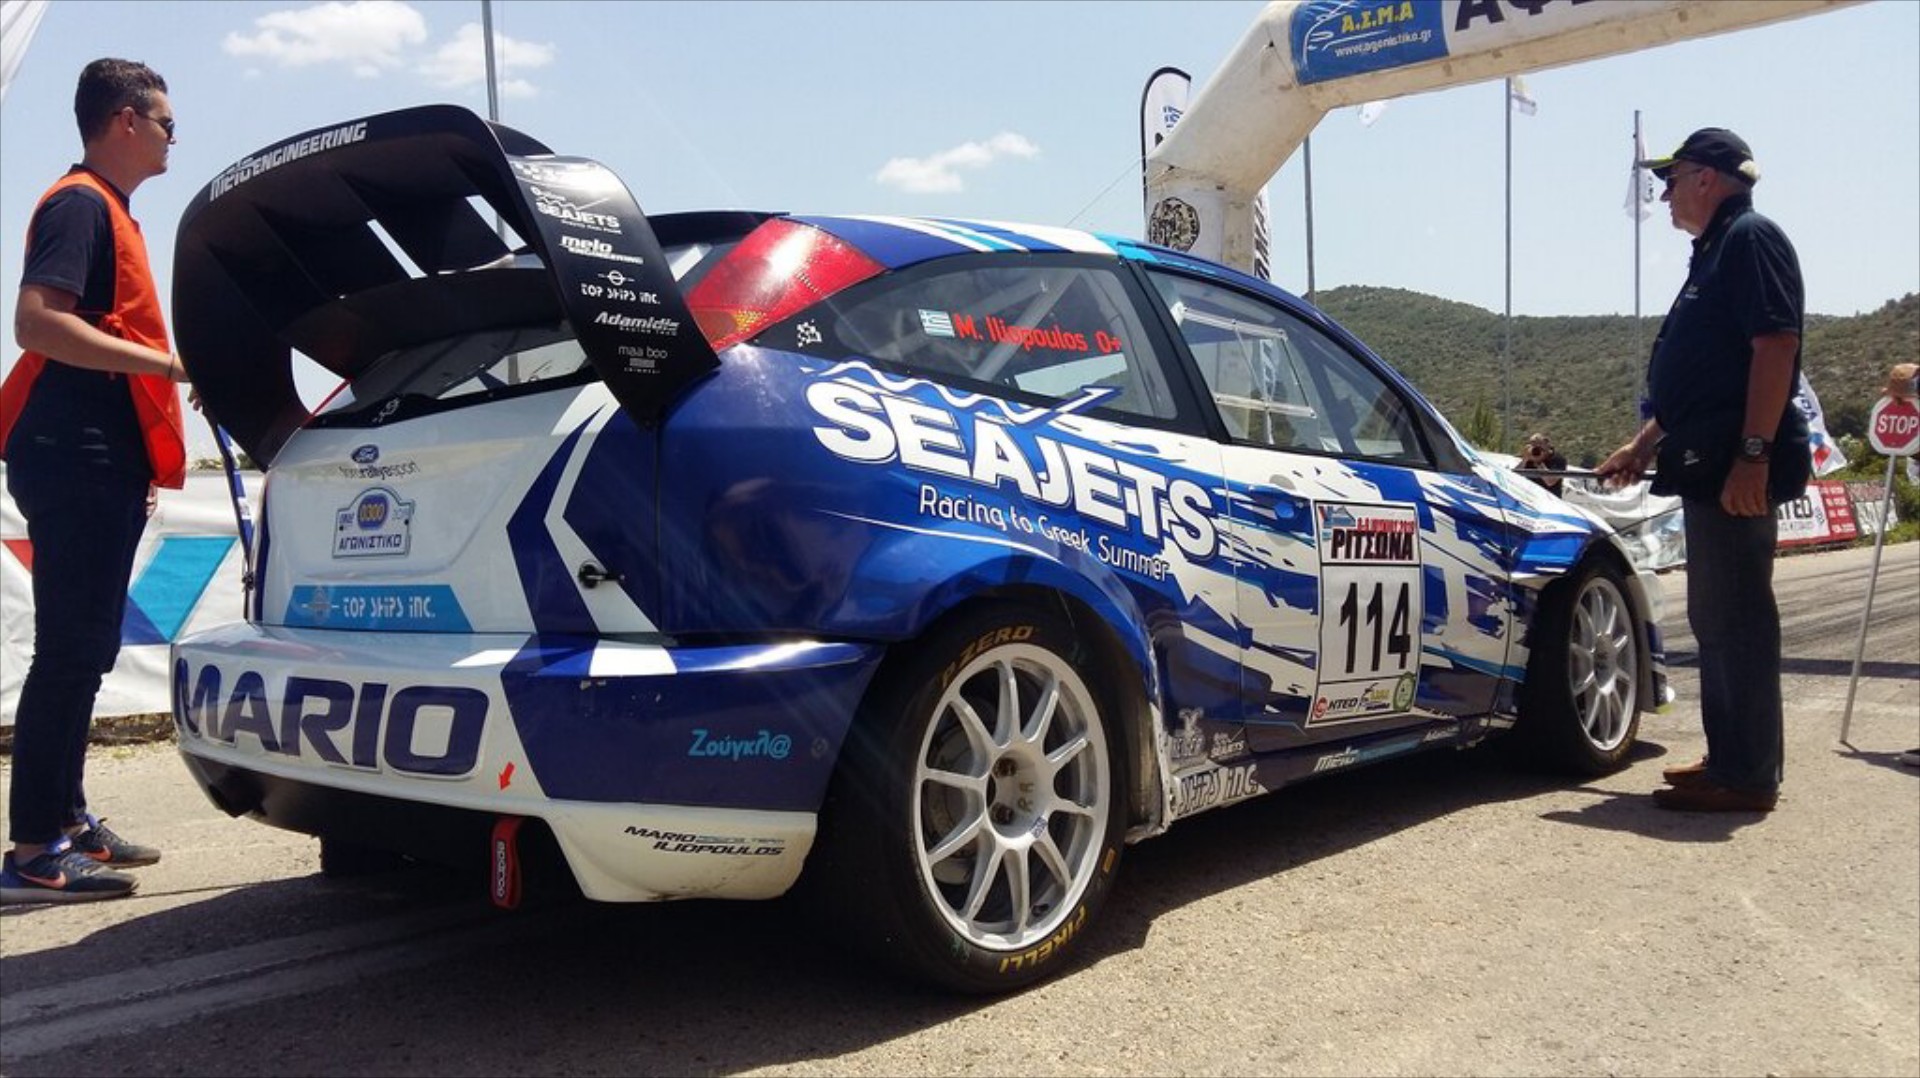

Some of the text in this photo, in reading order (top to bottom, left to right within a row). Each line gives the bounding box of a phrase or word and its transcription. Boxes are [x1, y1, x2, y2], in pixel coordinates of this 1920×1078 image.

[1334, 29, 1432, 57] www.agonistiko.gr
[253, 121, 368, 177] ENGINEERING
[536, 201, 620, 228] SEAJETS
[953, 313, 983, 341] M.
[985, 315, 1088, 351] Iliopoulos
[1877, 414, 1919, 434] STOP
[806, 379, 1219, 559] SEAJETS
[918, 484, 1171, 582] Racing to Greek Summer
[1331, 528, 1413, 560] ΡΙΤΣΩΝΑ
[343, 597, 364, 618] TOP
[1340, 582, 1411, 674] 114
[175, 657, 490, 778] MARIO
[624, 825, 696, 843] MARIO
[652, 841, 785, 856] ILIOPOULOS
[999, 905, 1087, 974] PIRELLI
